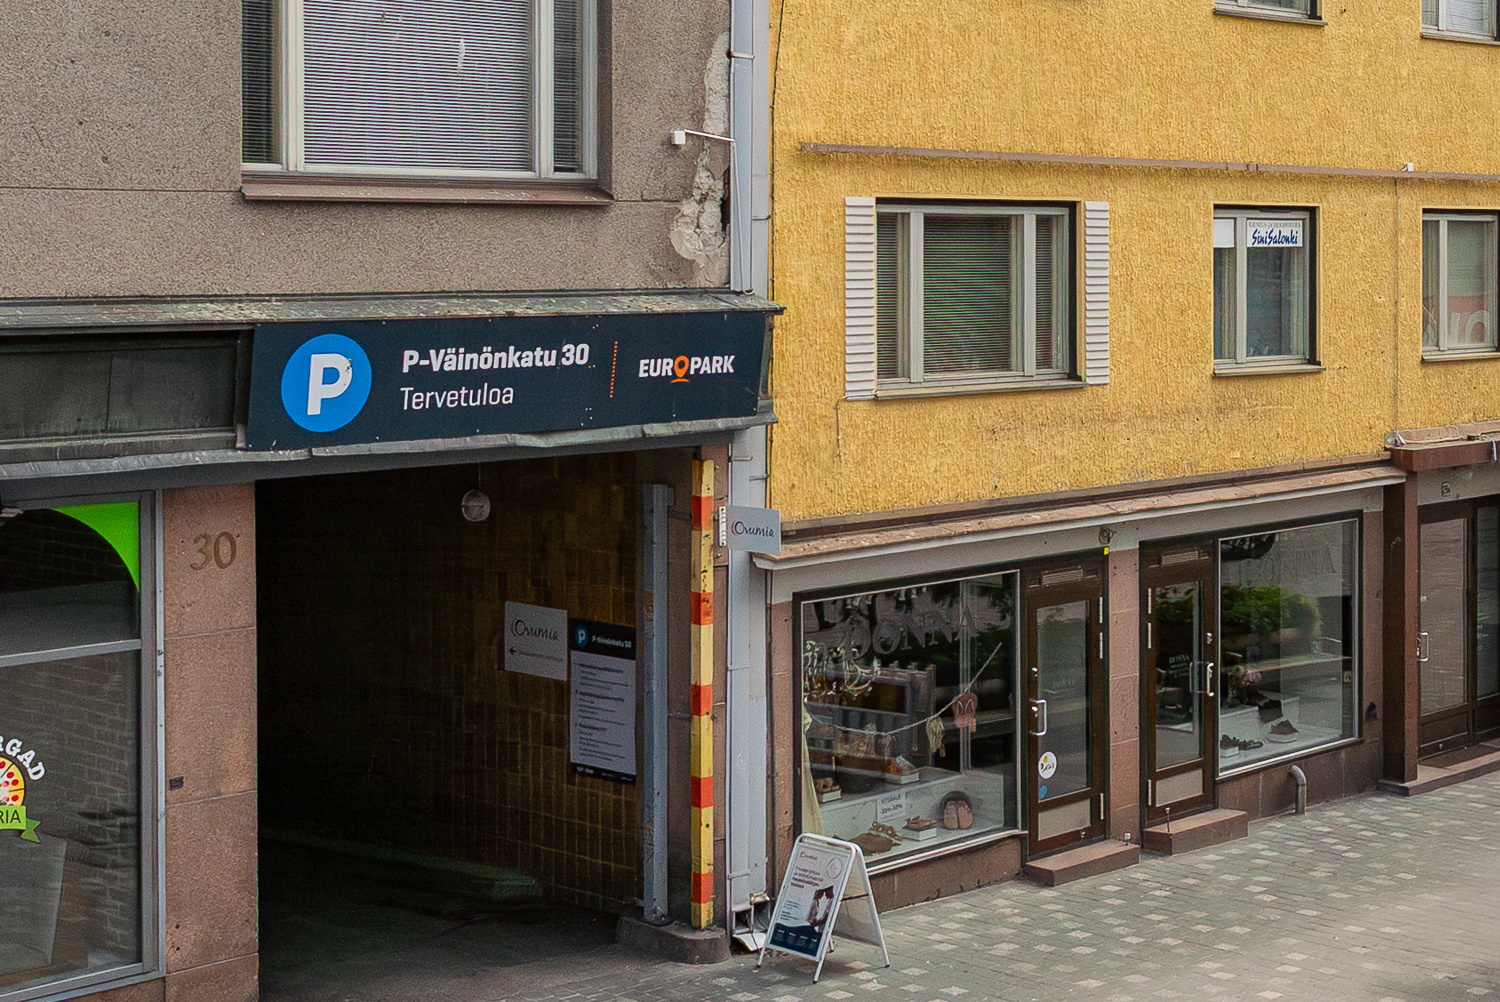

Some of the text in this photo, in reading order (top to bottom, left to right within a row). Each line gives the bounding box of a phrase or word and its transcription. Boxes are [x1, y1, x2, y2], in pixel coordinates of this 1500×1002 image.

[402, 342, 590, 374] P-Väinönkatu 30
[638, 354, 736, 382] EUROPARK
[399, 383, 515, 411] Tervetuloa
[731, 519, 775, 538] Ovumia
[190, 531, 237, 571] 30
[511, 618, 560, 642] Ovumia
